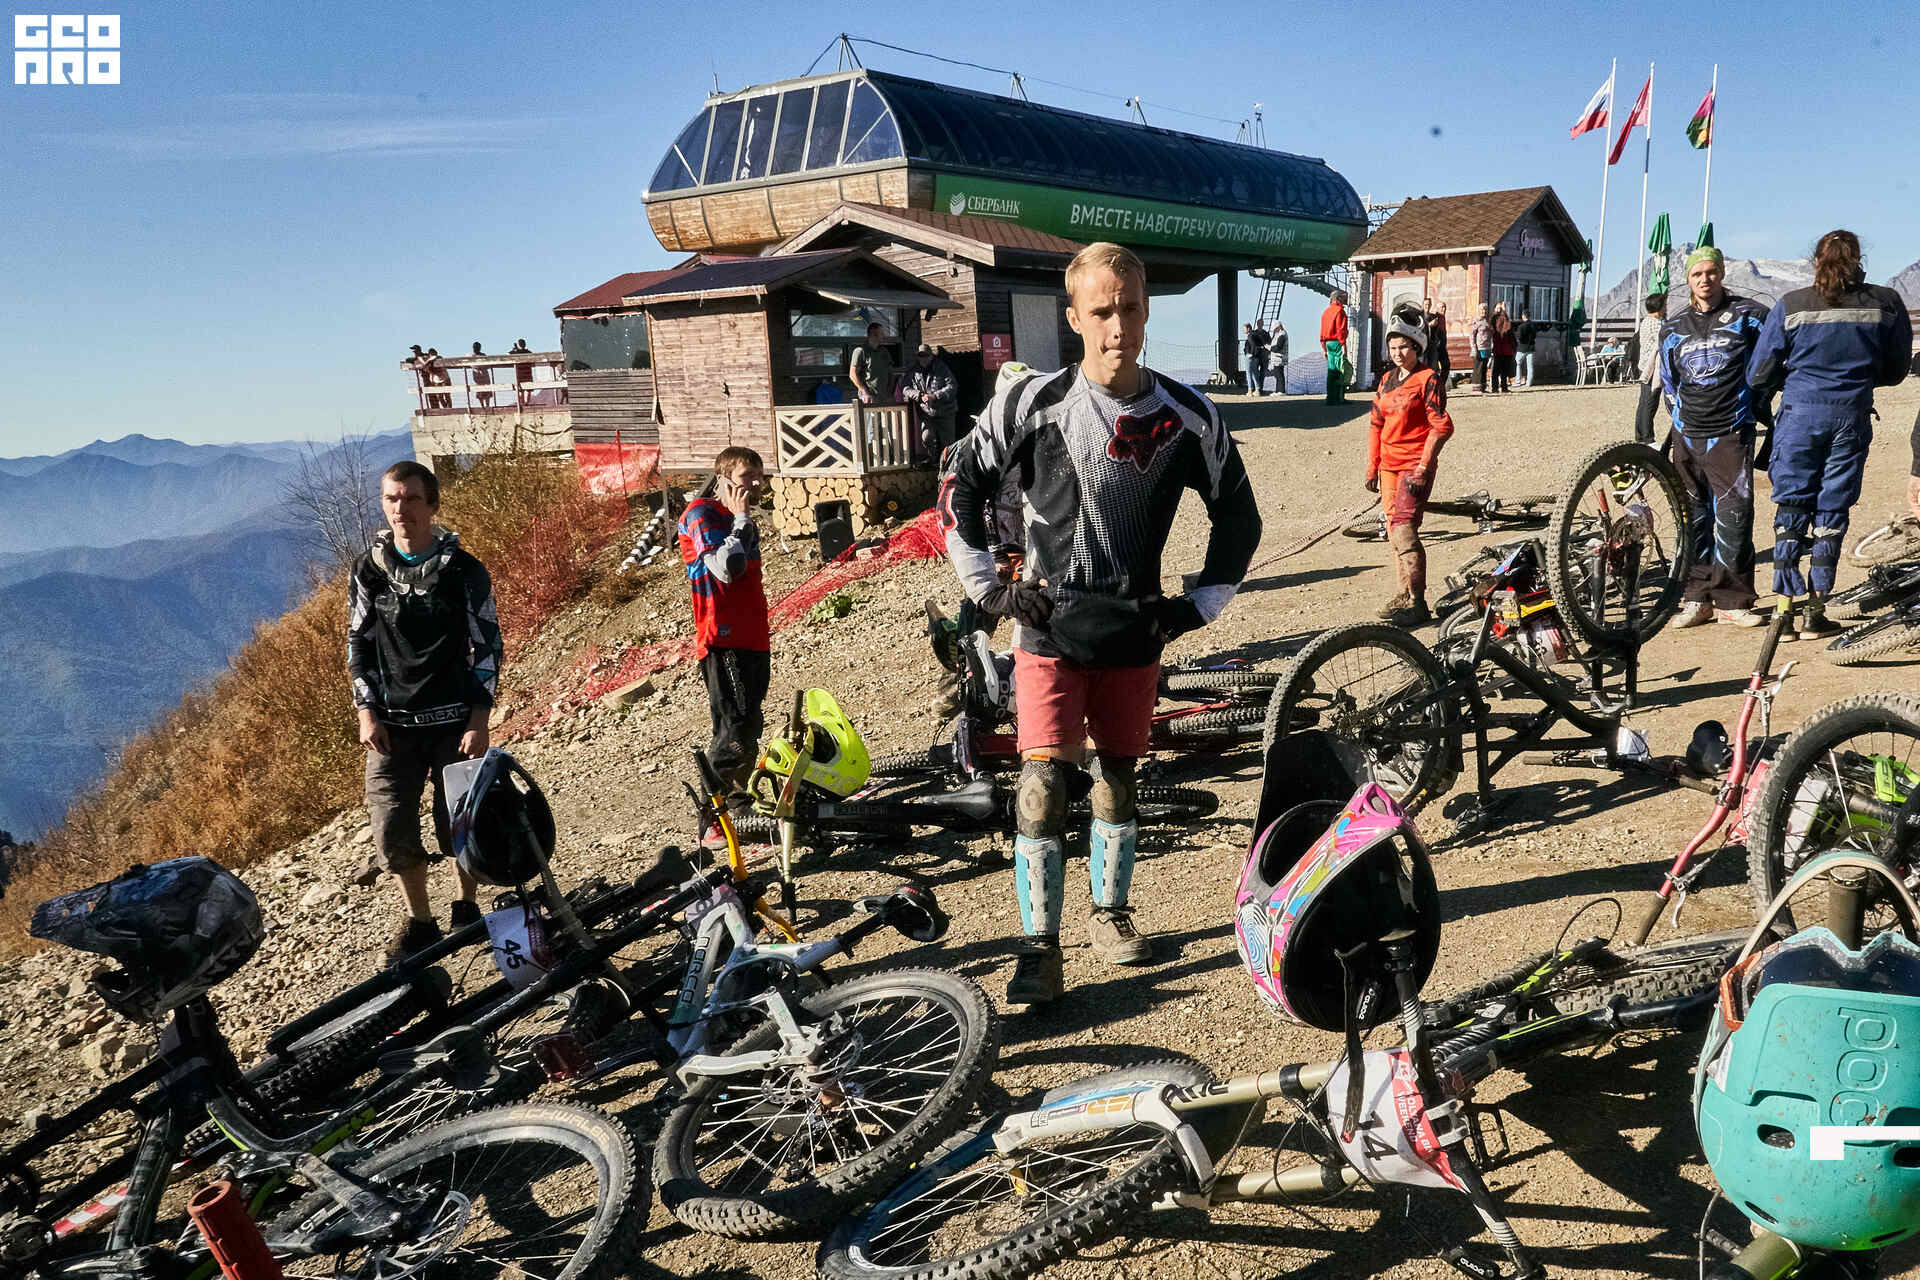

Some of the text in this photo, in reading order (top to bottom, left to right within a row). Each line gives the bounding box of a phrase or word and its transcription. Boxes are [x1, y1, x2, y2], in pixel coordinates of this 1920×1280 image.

[967, 195, 1021, 215] СБЕРБАНК
[1070, 203, 1132, 230] ВМЕСТЕ
[1133, 211, 1216, 240] НАВСТРЕЧУ
[1216, 222, 1296, 247] ОТКРЫТИЯМ!
[504, 938, 527, 970] 45
[507, 1107, 612, 1153] SCHWALBE
[1358, 1110, 1399, 1161] 14
